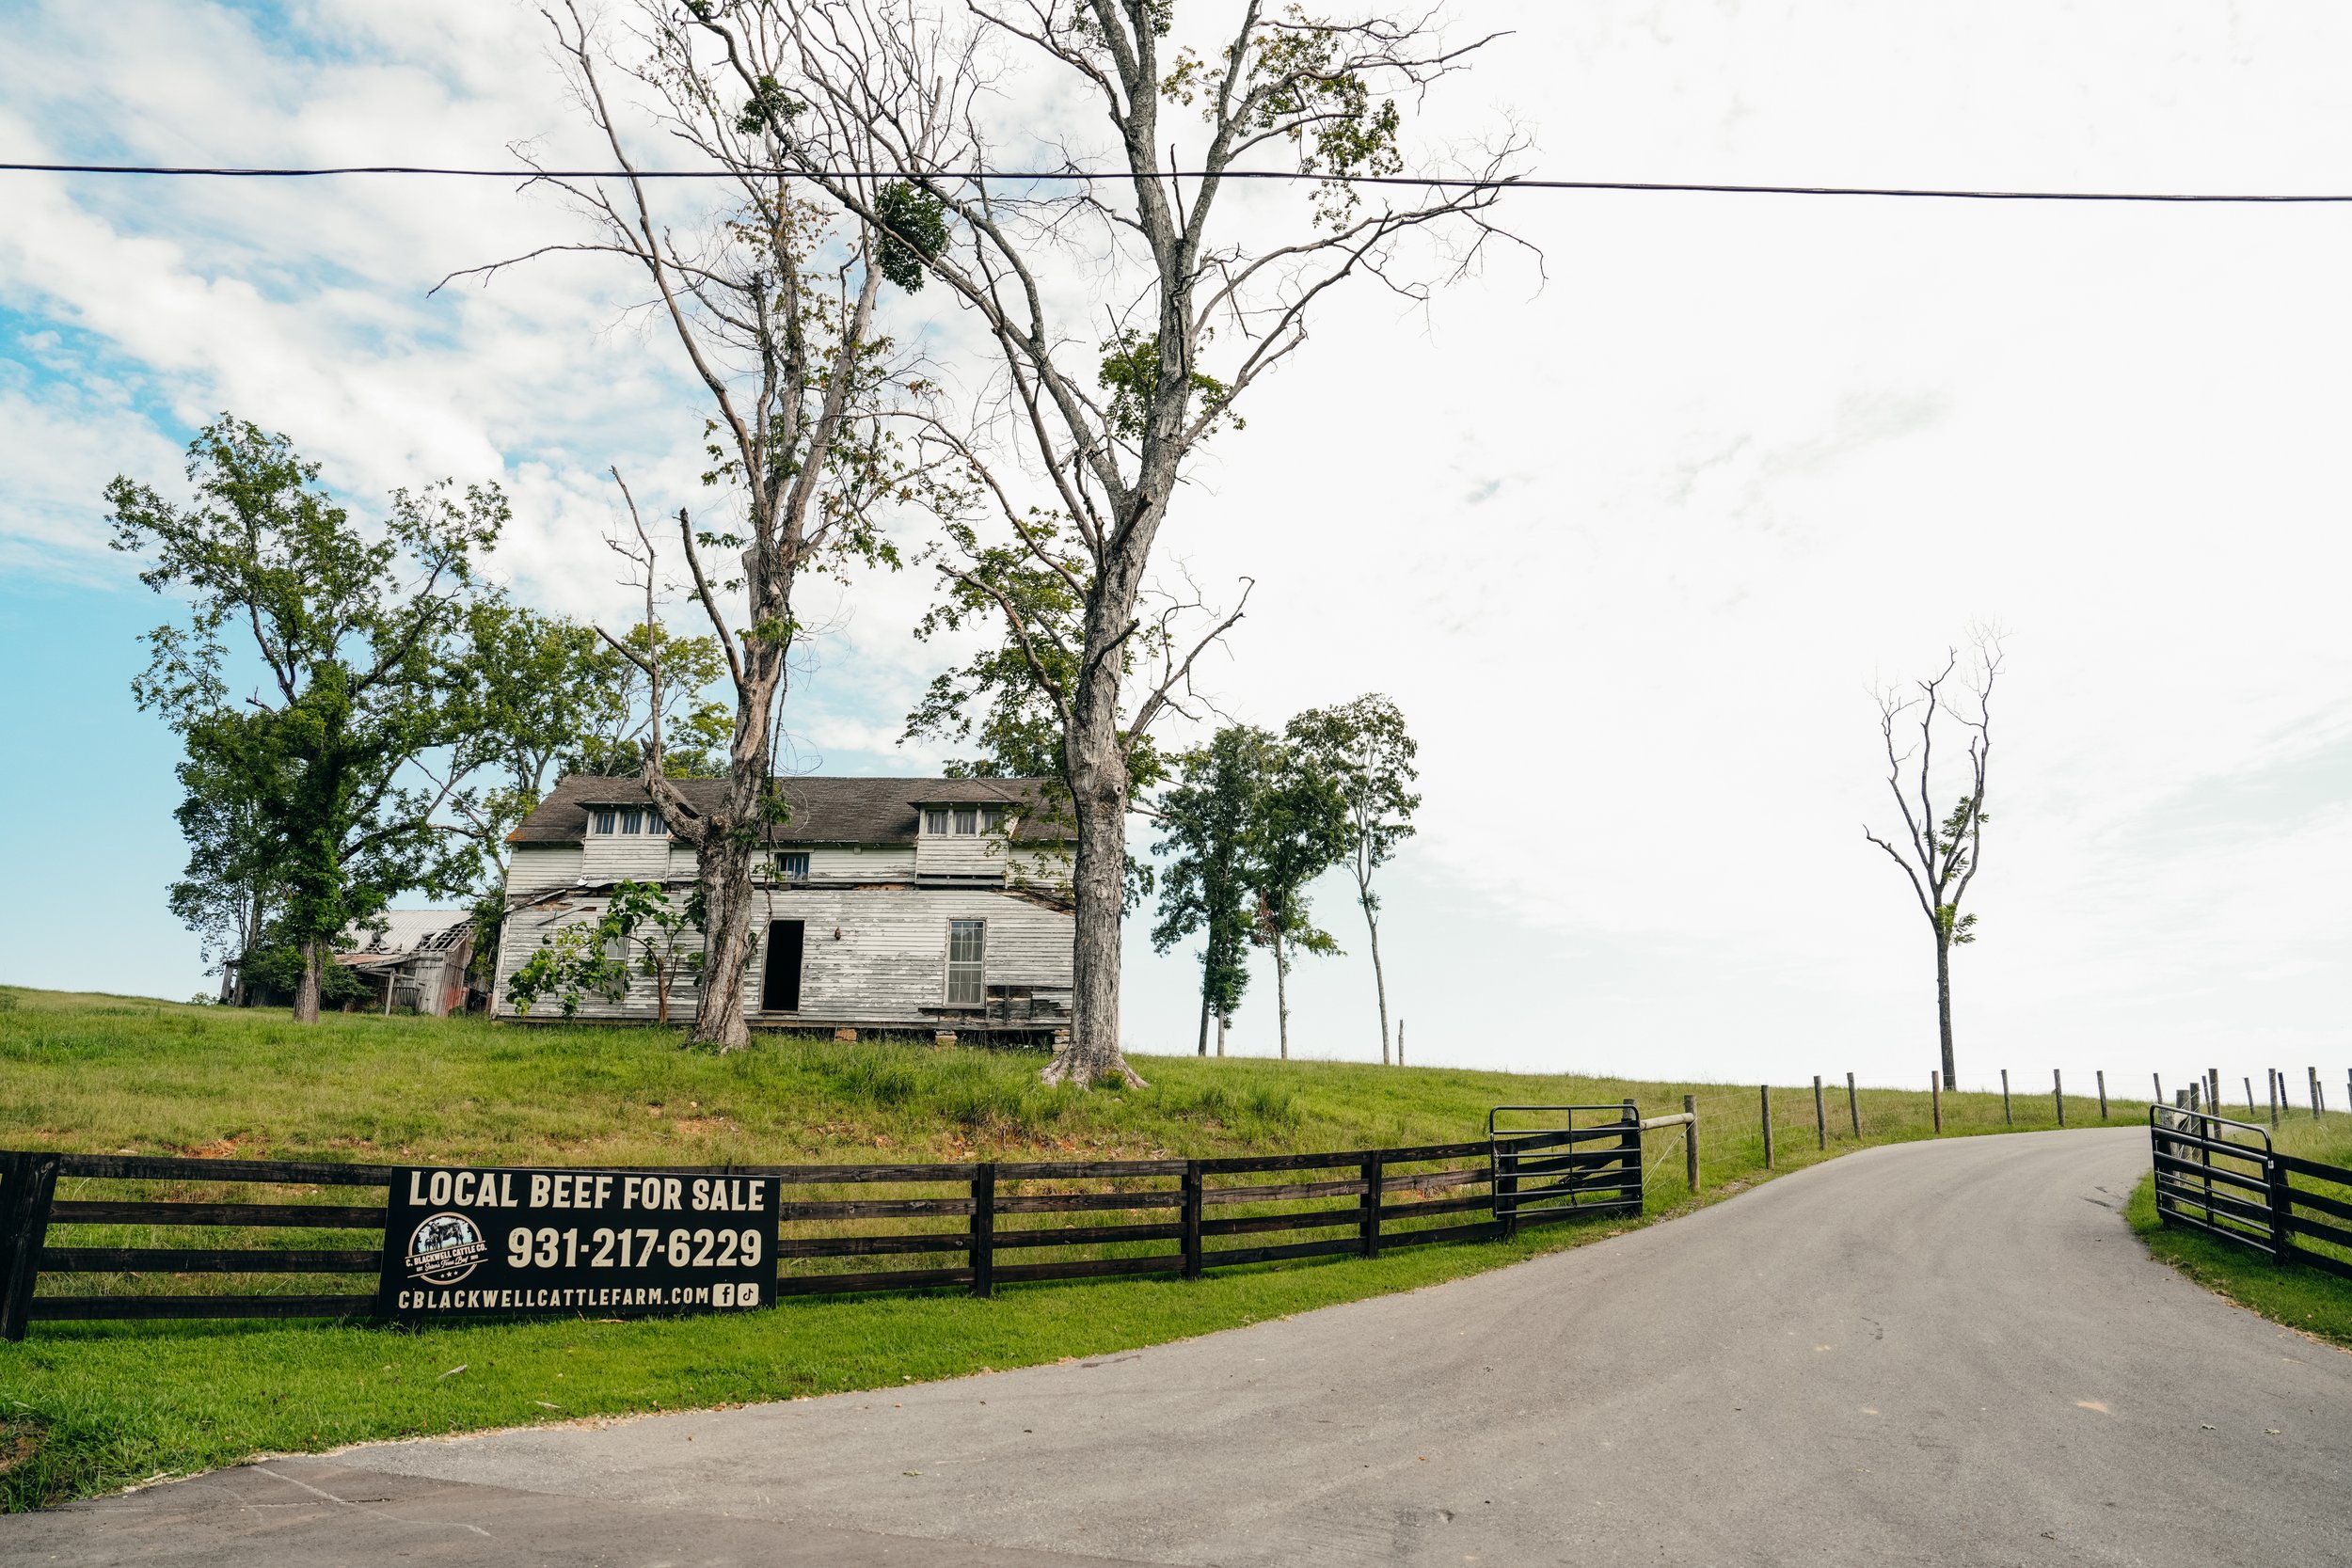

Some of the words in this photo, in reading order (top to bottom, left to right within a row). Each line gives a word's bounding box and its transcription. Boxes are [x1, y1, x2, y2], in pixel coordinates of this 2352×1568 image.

[408, 1171, 518, 1208] LOCAL
[530, 1174, 613, 1210] BEEF
[623, 1177, 683, 1212] FOR
[691, 1179, 766, 1212] SALE
[414, 1250, 453, 1266] BLACKWELL
[452, 1244, 476, 1258] CATTLE
[507, 1227, 763, 1269] 931-217-6229
[398, 1287, 709, 1309] CBLACKWELLCATTLEFARM.COM
